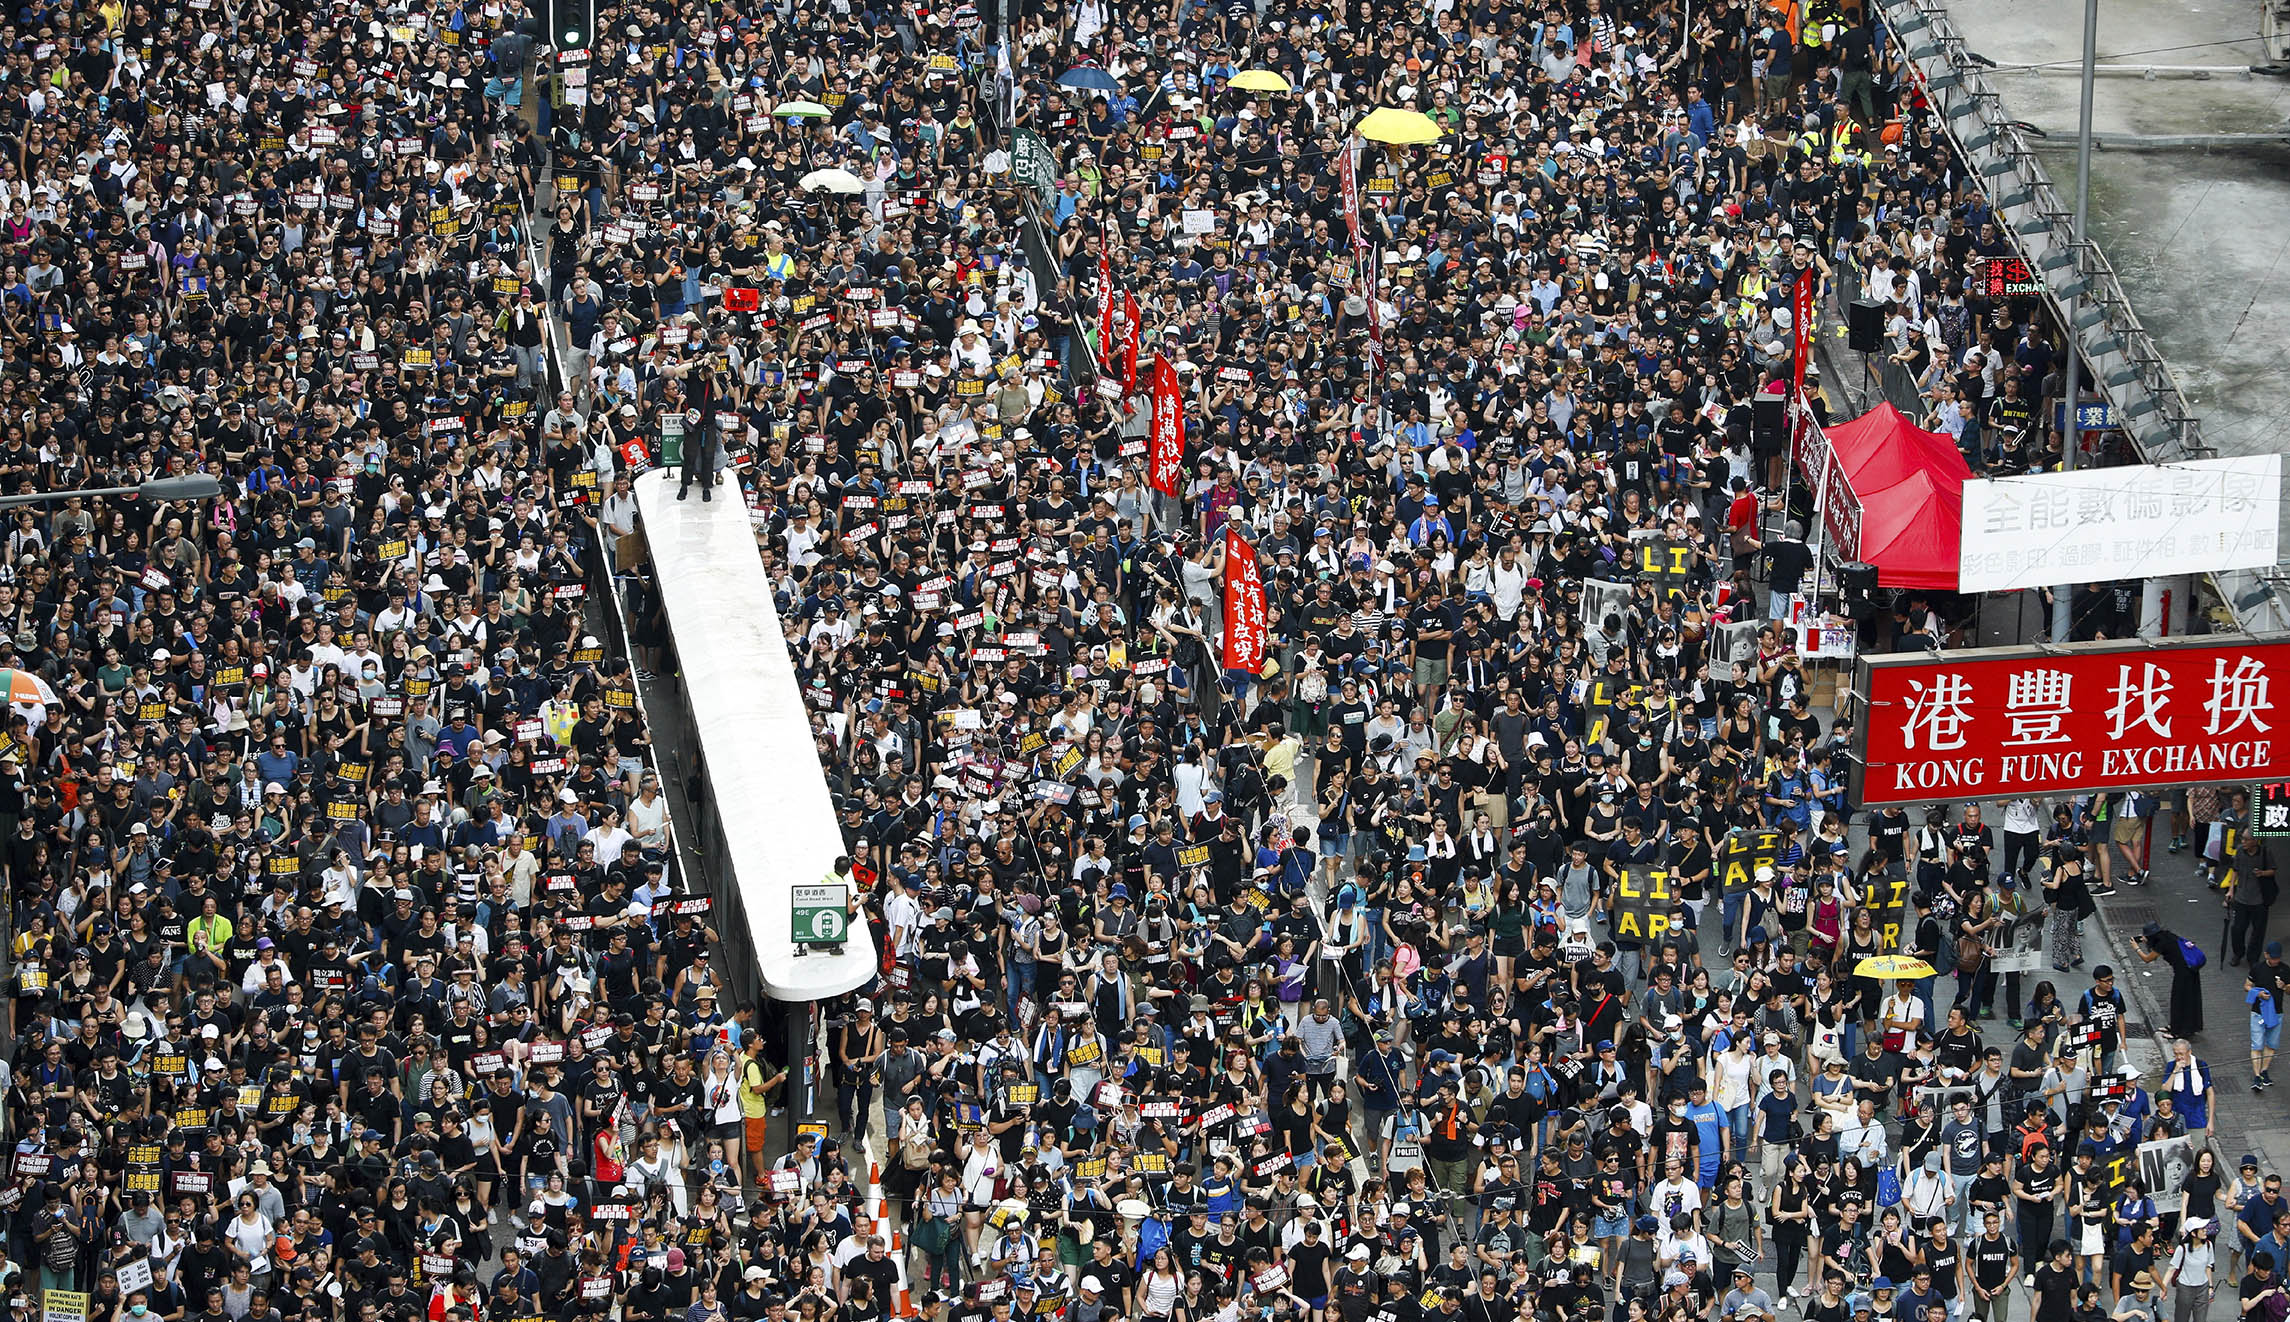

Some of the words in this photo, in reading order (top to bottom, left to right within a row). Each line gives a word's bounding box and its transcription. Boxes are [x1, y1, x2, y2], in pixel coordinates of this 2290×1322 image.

[1894, 757, 1985, 790] KONG
[1999, 751, 2083, 783] FUNG
[2100, 740, 2272, 777] EXCHANGE
